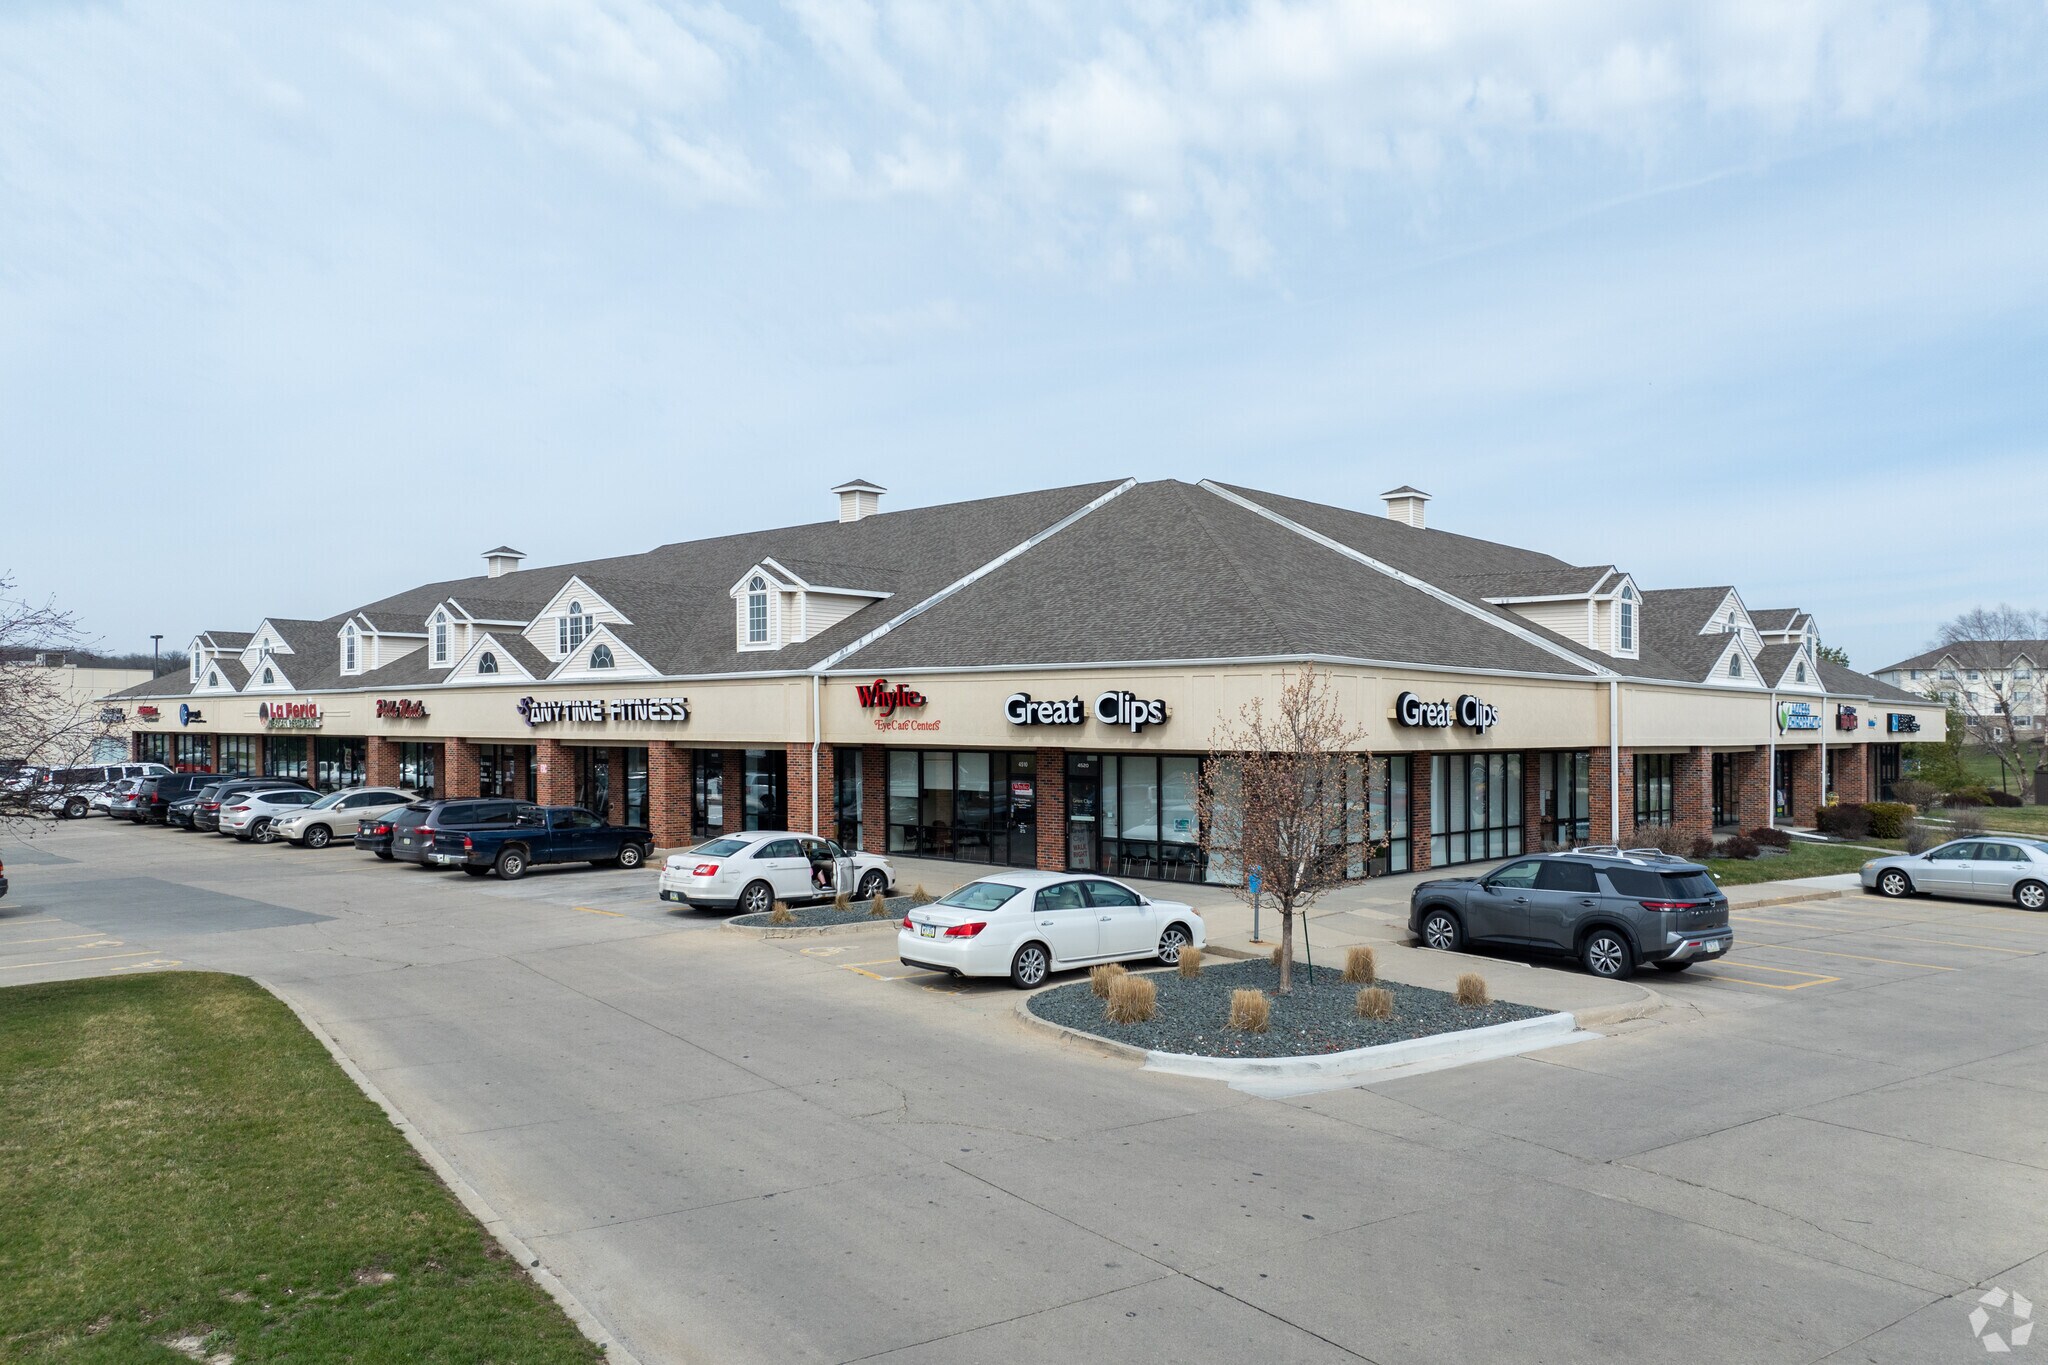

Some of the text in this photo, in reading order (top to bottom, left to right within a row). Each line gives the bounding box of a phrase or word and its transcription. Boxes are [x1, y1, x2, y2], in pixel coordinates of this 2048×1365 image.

[269, 702, 317, 718] La Feria
[530, 698, 688, 722] ANYTIME FITNESS
[855, 679, 927, 717] Whylie
[1004, 690, 1163, 732] Great Clips
[1400, 692, 1499, 734] Great Clips
[874, 719, 941, 732] Eye Care Centers
